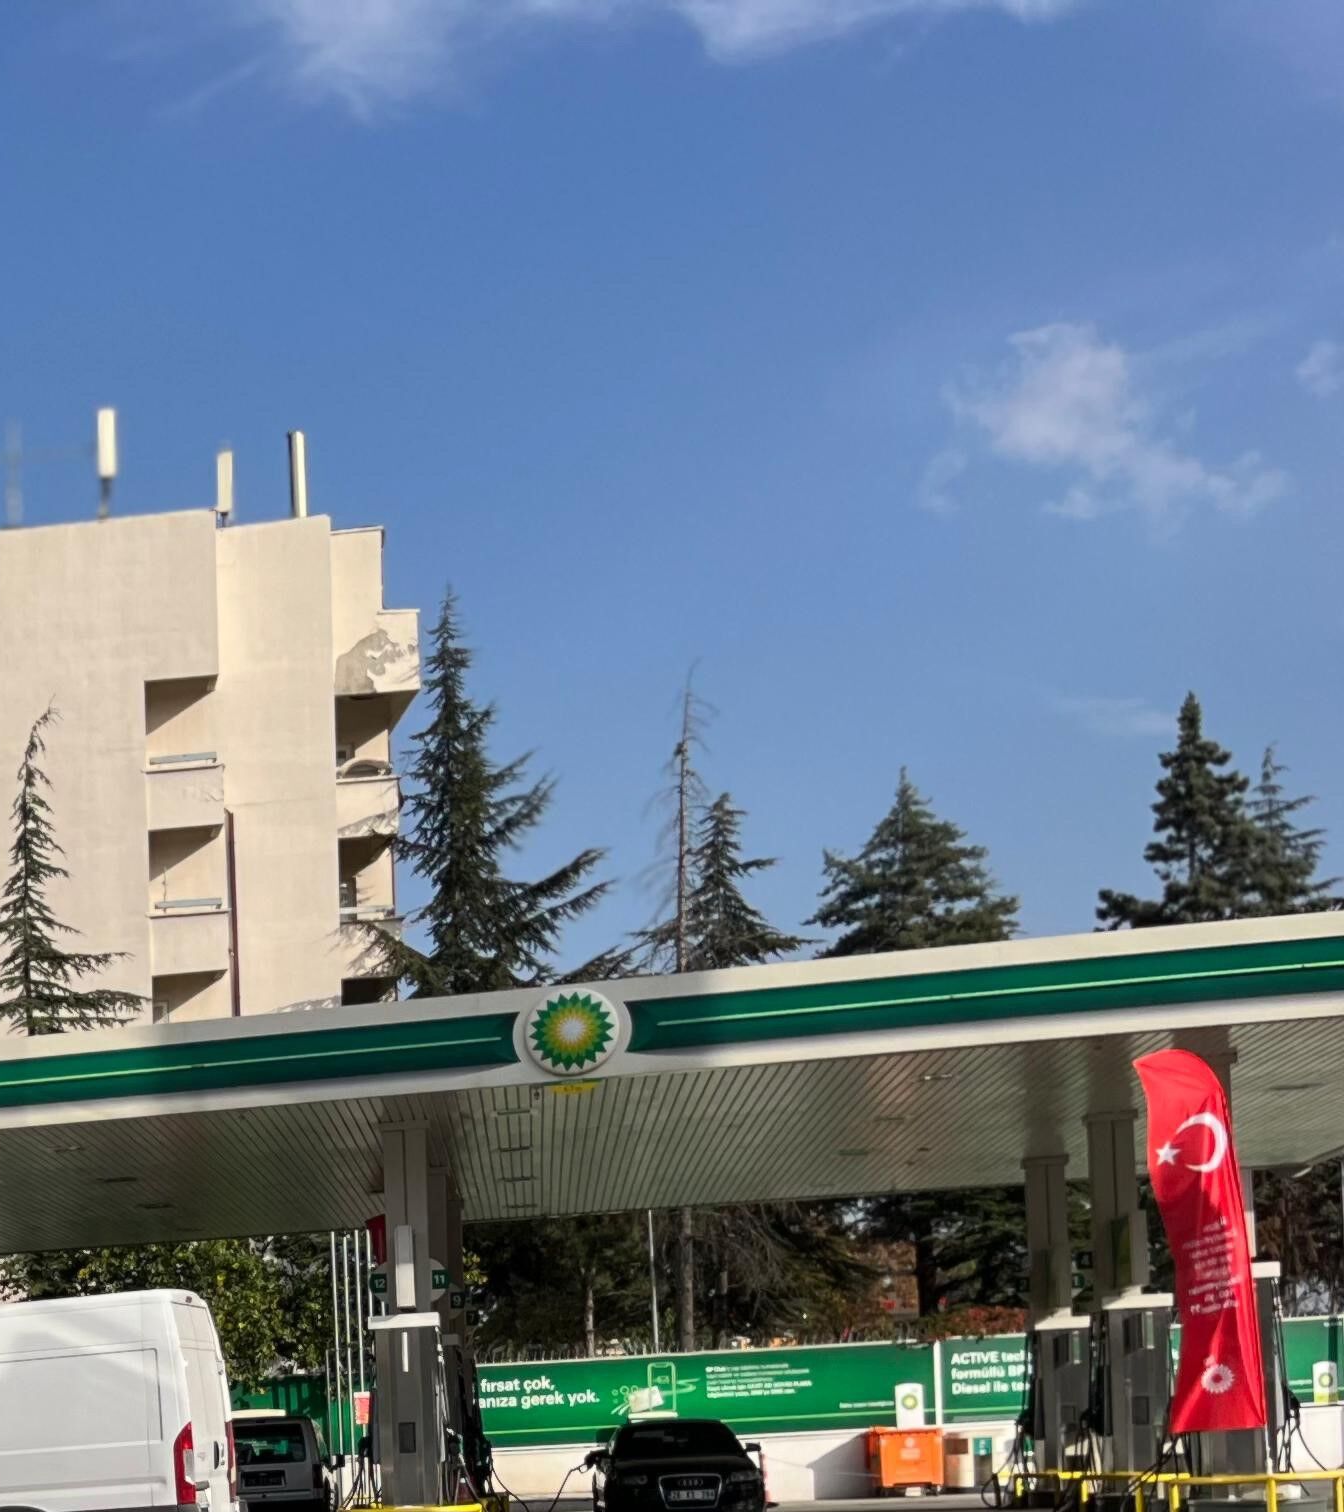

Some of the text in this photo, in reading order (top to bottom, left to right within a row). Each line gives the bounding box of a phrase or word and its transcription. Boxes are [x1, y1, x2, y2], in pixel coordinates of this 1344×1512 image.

[374, 1279, 386, 1289] 12
[433, 1274, 446, 1286] 11
[951, 1350, 1000, 1365] ACTIVE
[523, 1375, 556, 1394] çok,
[952, 1381, 991, 1395] Diesel
[520, 1390, 565, 1409] gerek
[567, 1388, 600, 1407] yok.
